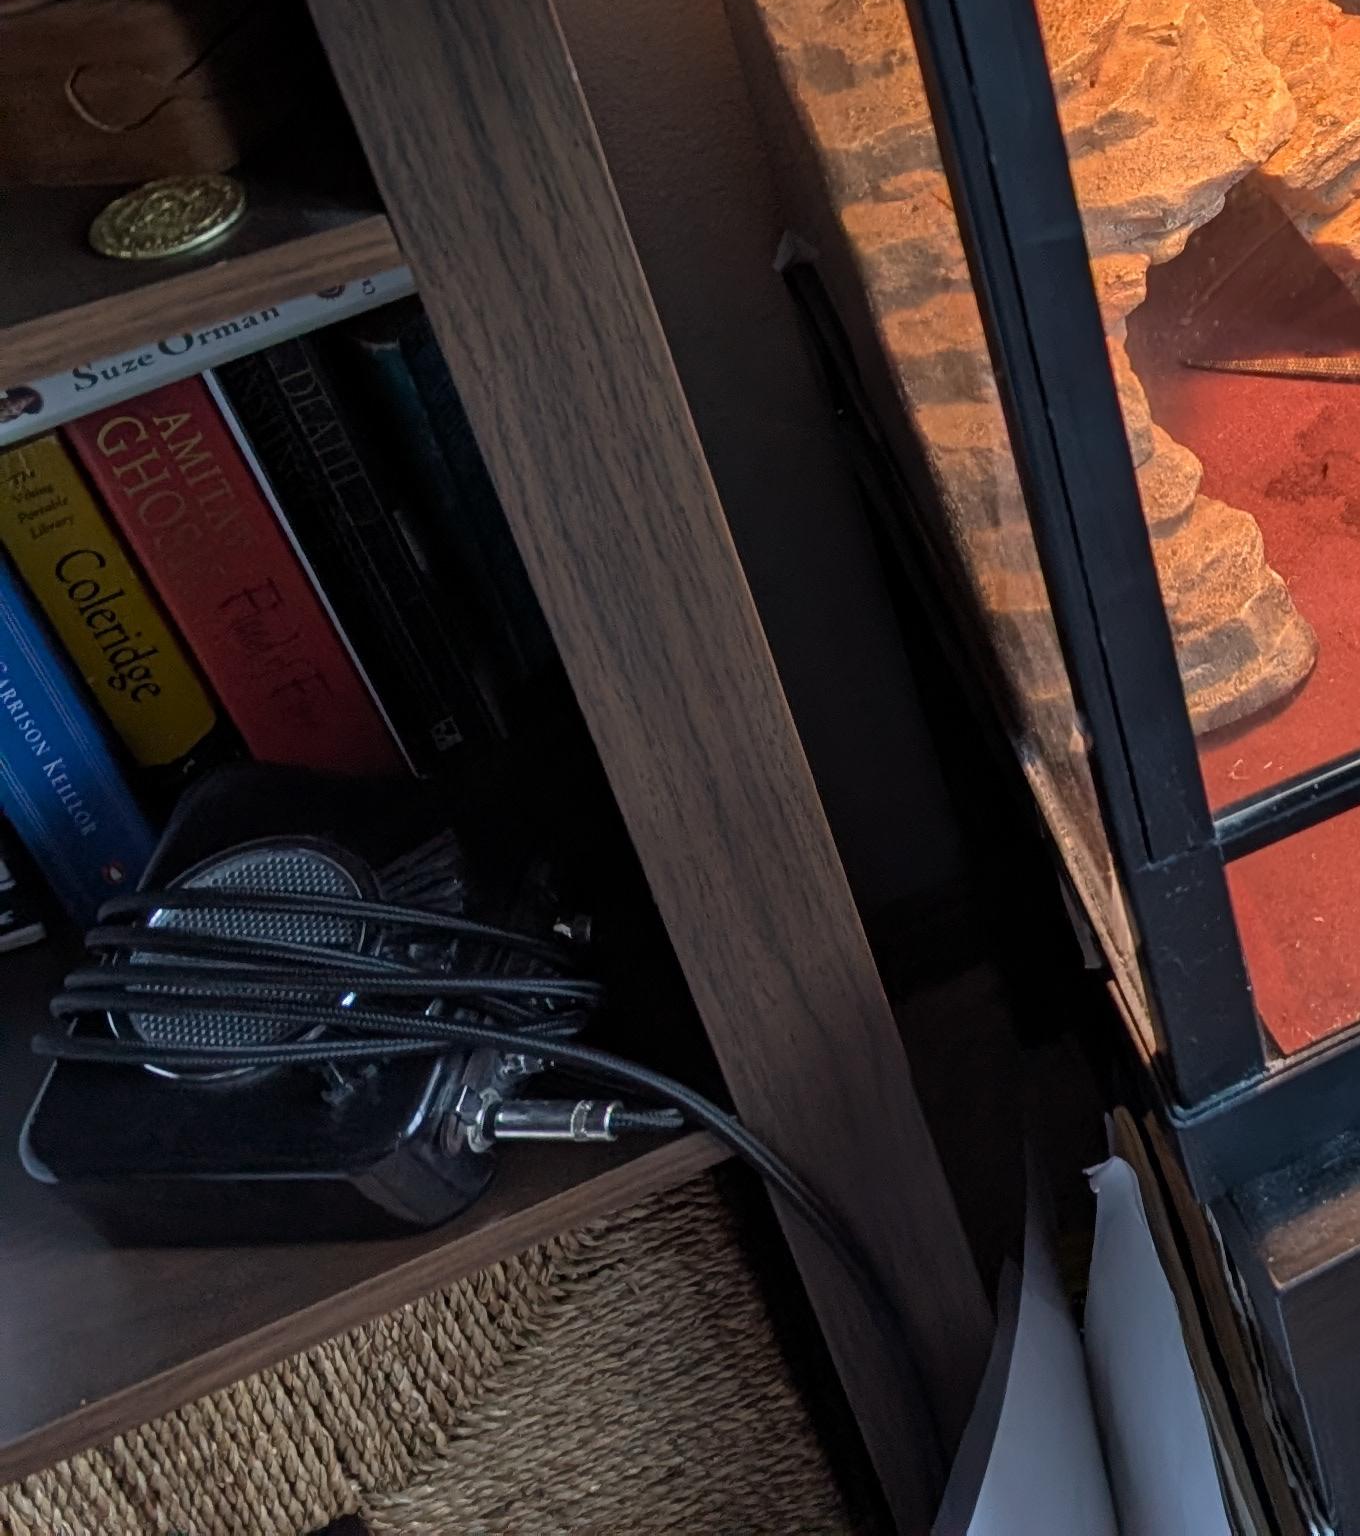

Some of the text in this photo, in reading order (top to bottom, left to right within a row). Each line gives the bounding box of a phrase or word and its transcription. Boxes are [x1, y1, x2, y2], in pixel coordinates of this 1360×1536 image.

[73, 304, 281, 393] Suze Orman
[54, 549, 162, 704] Coleridge
